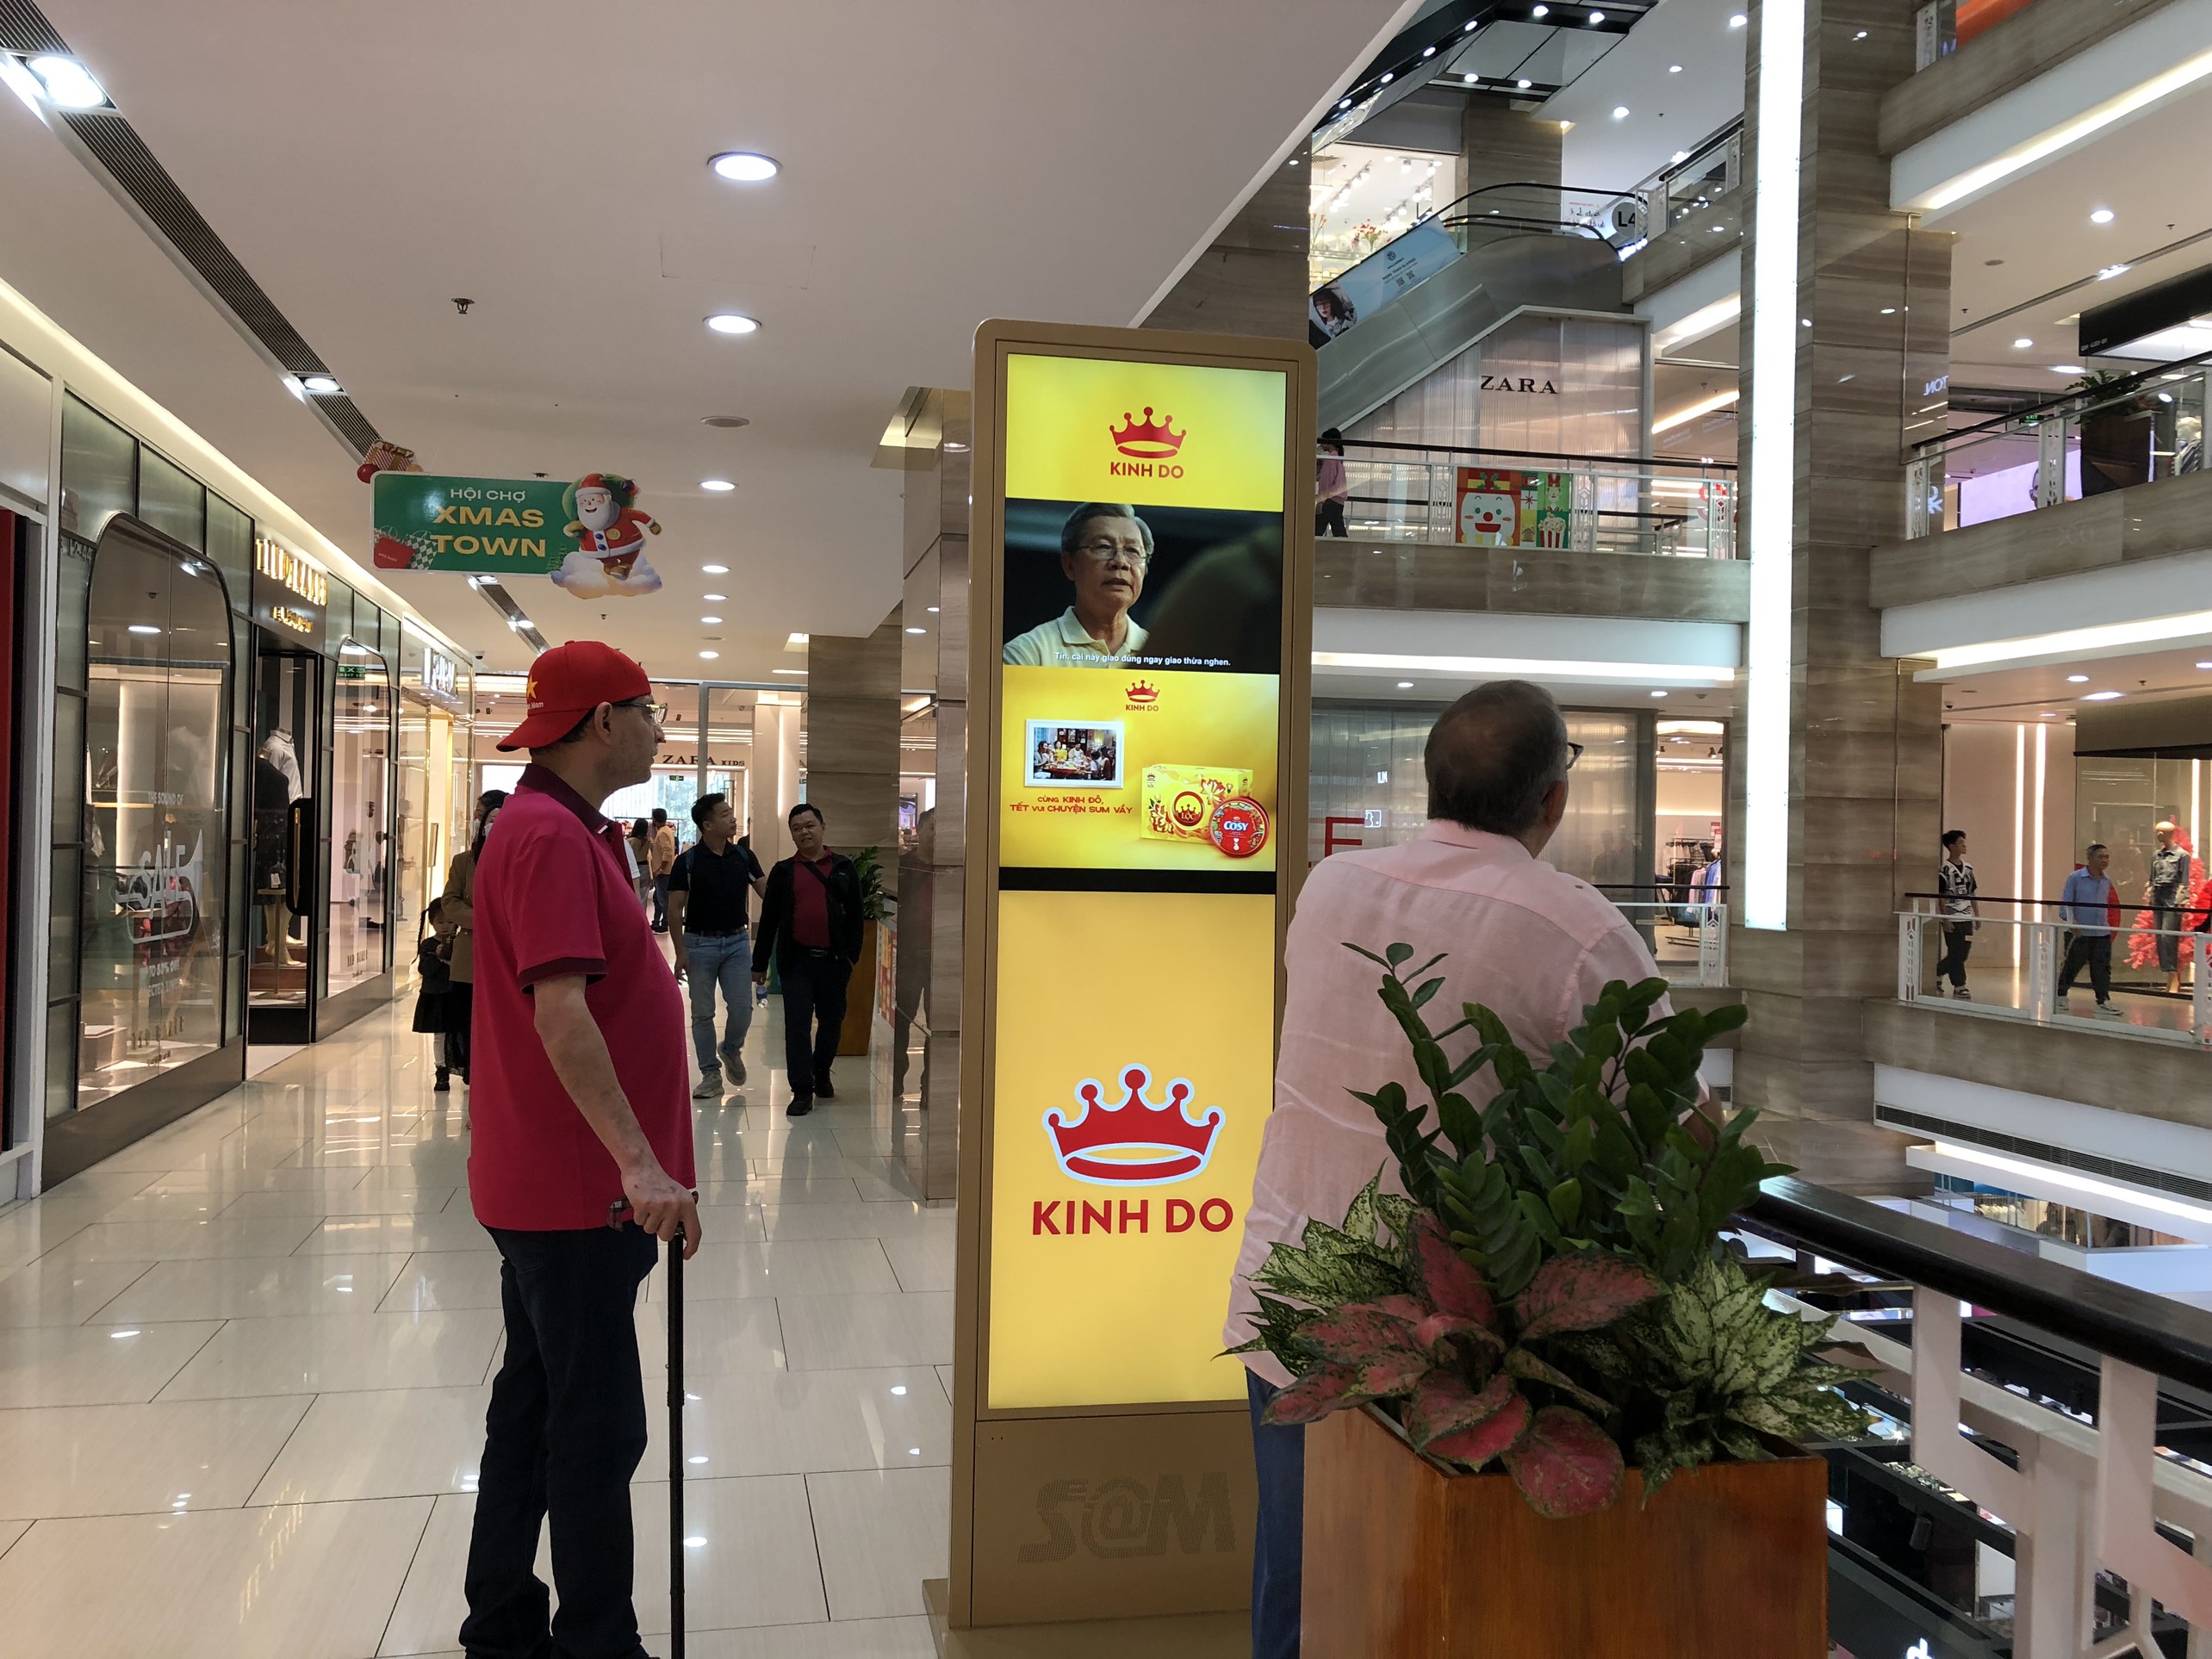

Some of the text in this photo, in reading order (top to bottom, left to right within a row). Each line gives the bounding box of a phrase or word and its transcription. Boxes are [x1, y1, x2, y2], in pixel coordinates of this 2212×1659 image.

[1481, 374, 1559, 395] ZARA
[1109, 461, 1184, 480] KINH DO
[450, 487, 526, 503] HỘI CHỢ
[432, 506, 544, 529] XMAS
[429, 534, 547, 558] TOWN
[1072, 652, 1084, 661] cái
[1102, 654, 1119, 664] giao
[1143, 656, 1163, 666] ngay
[1165, 656, 1182, 666] giao
[1203, 657, 1232, 667] nghen.
[1010, 799, 1029, 812] TẾT
[1047, 804, 1086, 815] CHUYỆN
[1089, 805, 1110, 814] SUM
[1037, 794, 1059, 803] CÙNG
[1087, 795, 1104, 805] ĐÔ,
[1223, 820, 1249, 832] COSY
[133, 830, 188, 920] SALE
[1032, 1197, 1233, 1236] KINH DO
[1017, 1471, 1237, 1564] S@M
